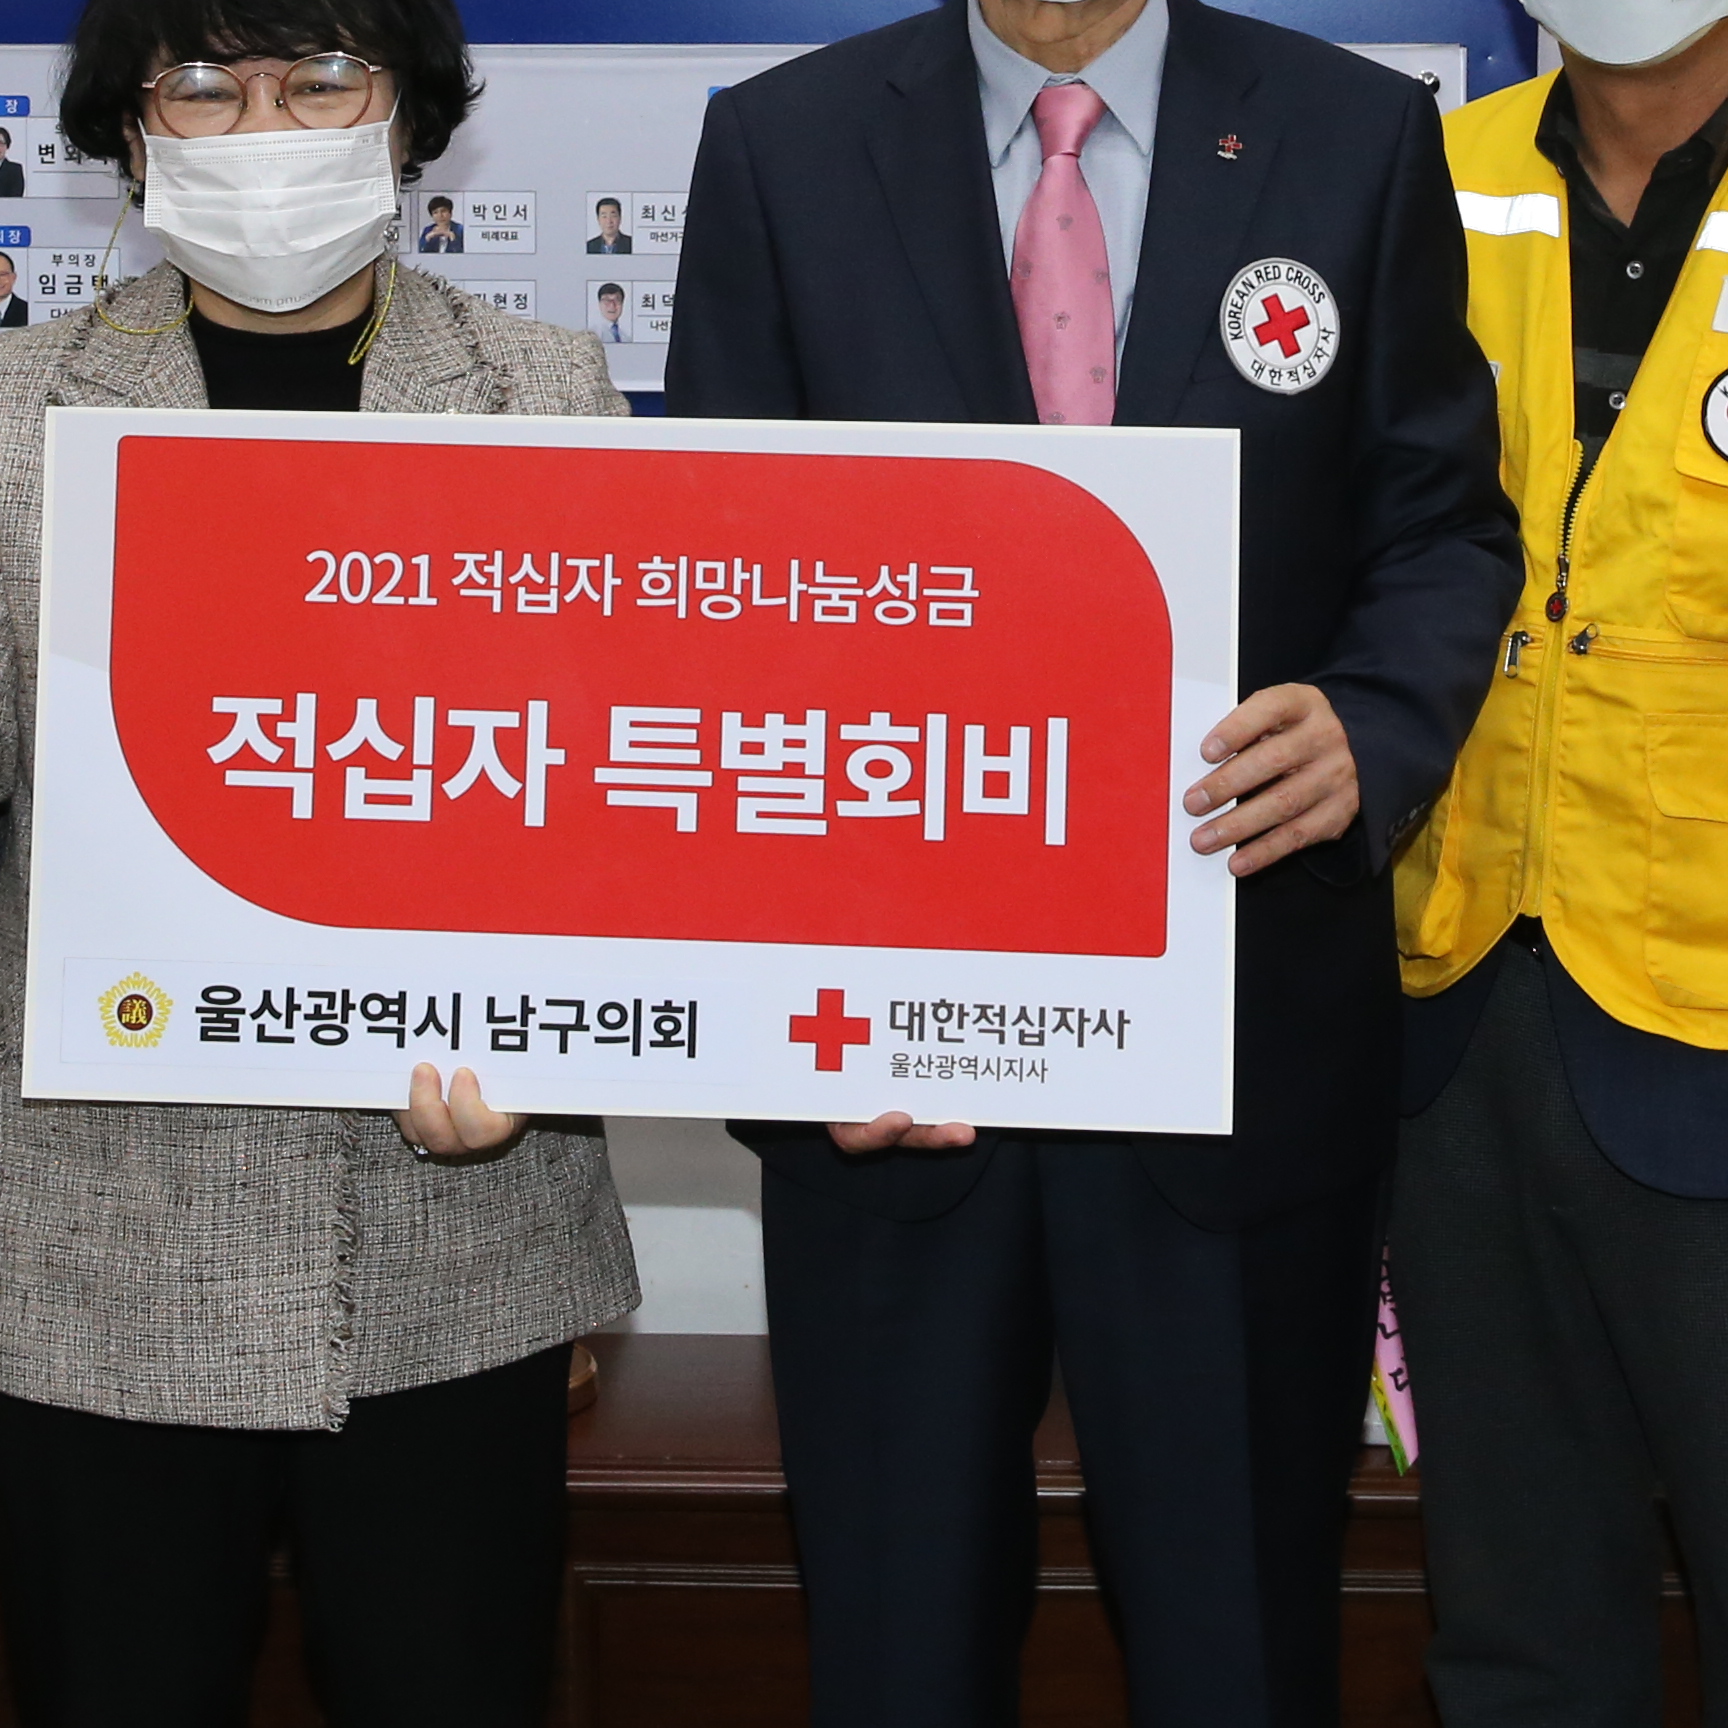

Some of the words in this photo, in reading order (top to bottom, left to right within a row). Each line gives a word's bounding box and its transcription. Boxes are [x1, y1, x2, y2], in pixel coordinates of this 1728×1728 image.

[472, 203, 528, 221] 박인서
[481, 230, 519, 241] 비례대표
[51, 254, 96, 267] 부의장
[1228, 277, 1256, 341] KOREAN
[1254, 265, 1281, 285] RED
[1286, 267, 1325, 304] CROSS
[304, 549, 438, 610] 2021
[450, 552, 621, 620] 적십자
[636, 557, 981, 629] 희망나눔성금
[206, 691, 565, 827] 적십자
[593, 706, 1070, 848] 특별회비
[193, 983, 464, 1051] 울산광역시
[485, 991, 699, 1060] 남구의회
[888, 998, 1131, 1051] 대한적십자사
[888, 1051, 1049, 1085] 울산광역시지사
